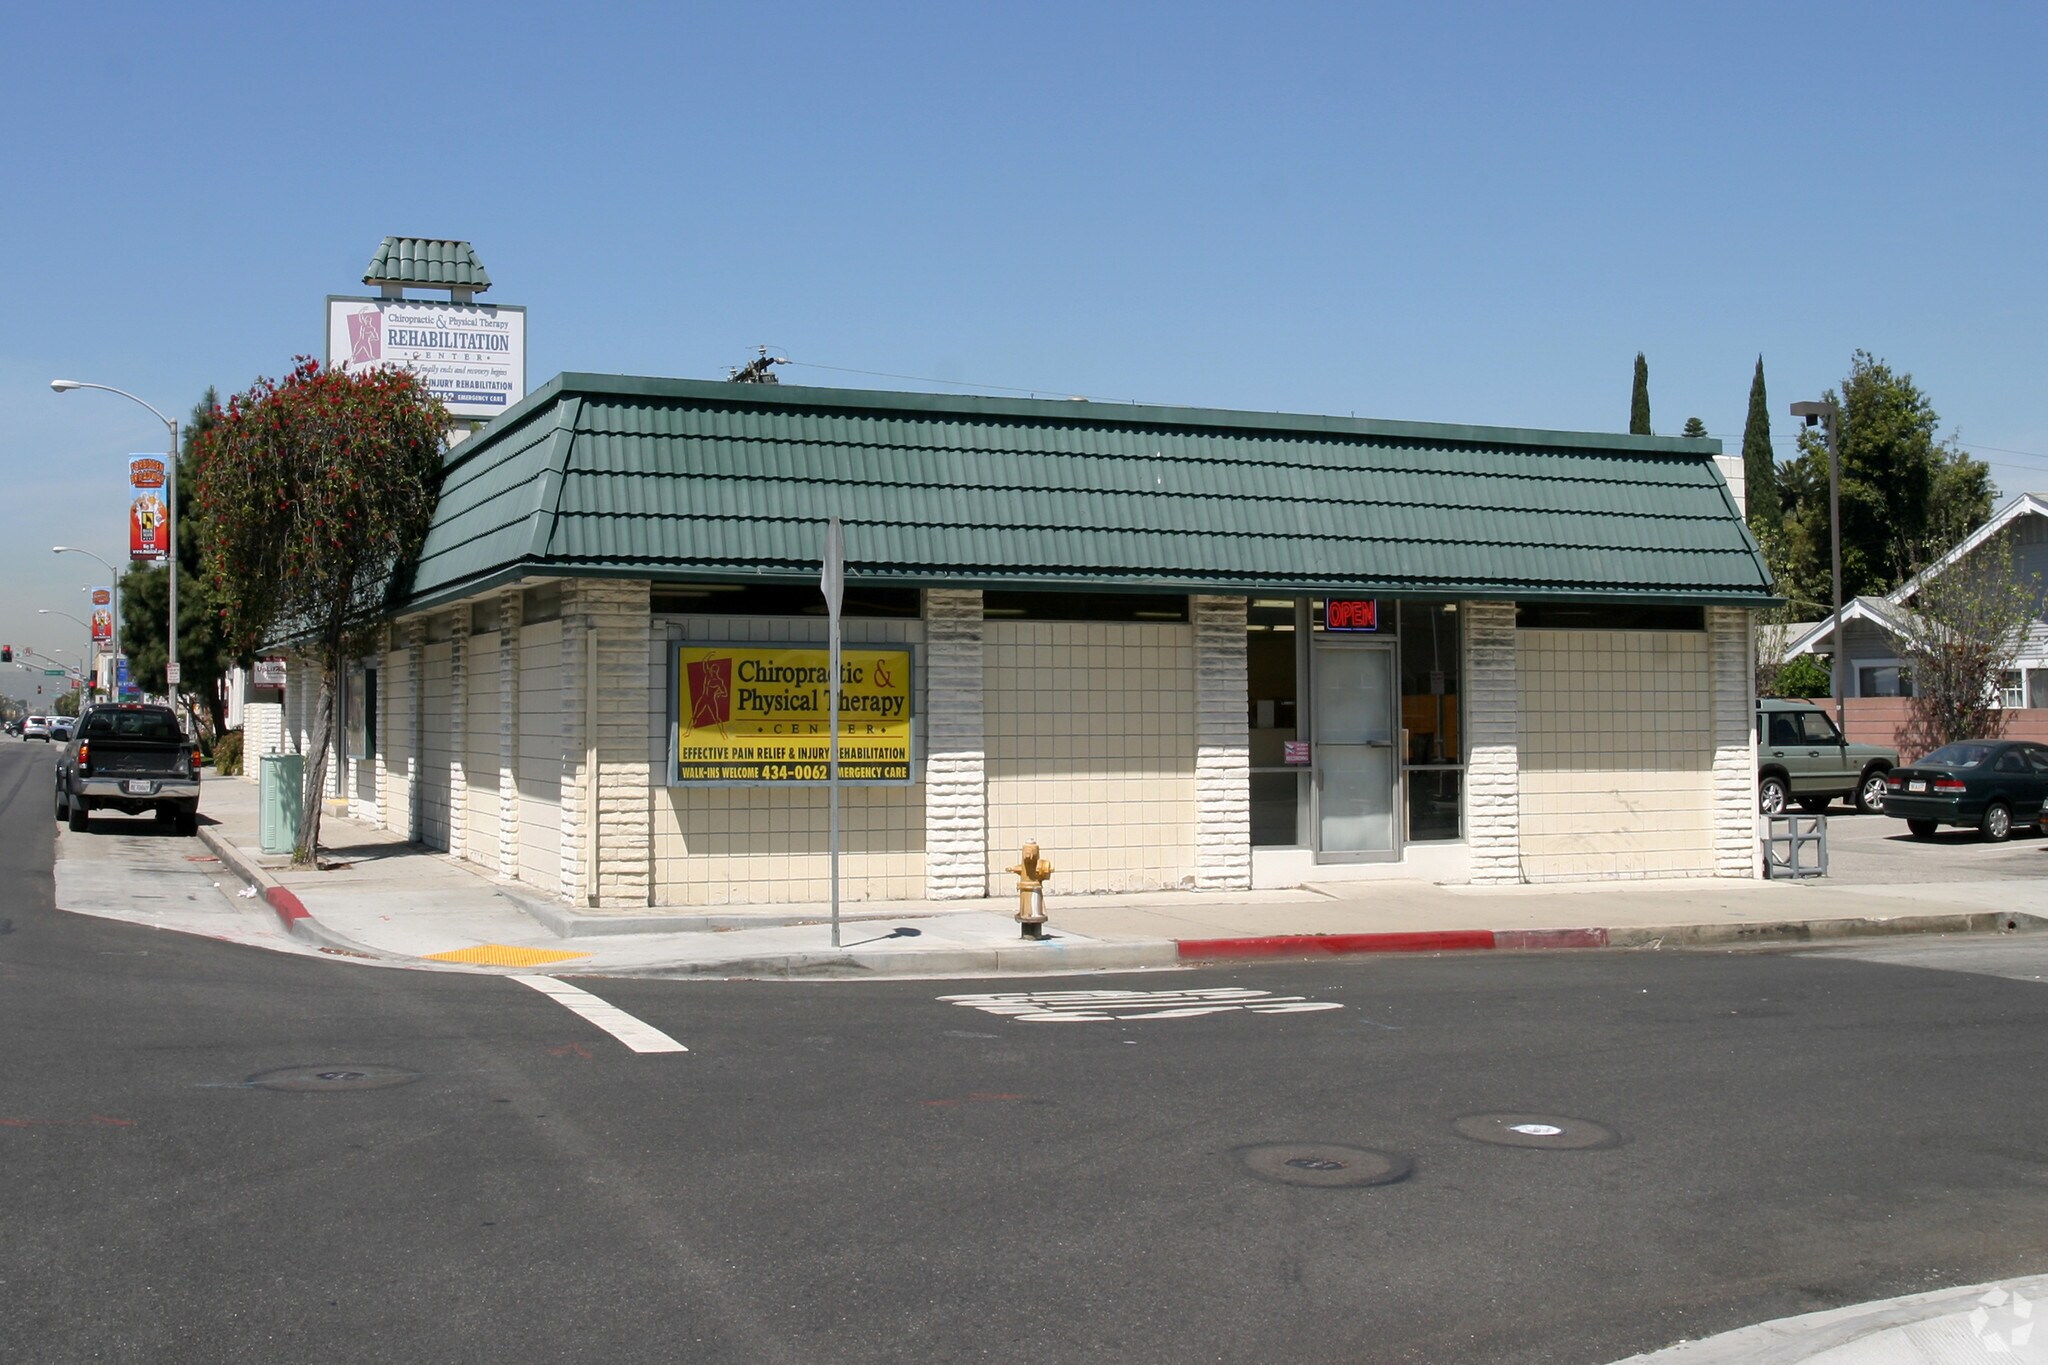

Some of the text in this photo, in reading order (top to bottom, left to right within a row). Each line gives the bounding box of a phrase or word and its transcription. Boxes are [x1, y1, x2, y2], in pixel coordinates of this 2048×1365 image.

[388, 313, 509, 329] Chiropractic & Physical Therapy
[388, 329, 509, 351] REHABILITATION
[456, 380, 513, 391] REHABILITATION
[1329, 601, 1374, 627] OPEN
[738, 658, 896, 688] Chiropratic &
[737, 688, 818, 715] Physical
[774, 724, 875, 735] CENER
[683, 747, 906, 760] EFFECTIVE PAIN RELIEF & INJURY EHABILITATION
[682, 767, 720, 779] WALK-INS
[722, 767, 759, 779] WELCOME
[762, 764, 827, 780] 434-0062
[884, 767, 907, 779] CARE
